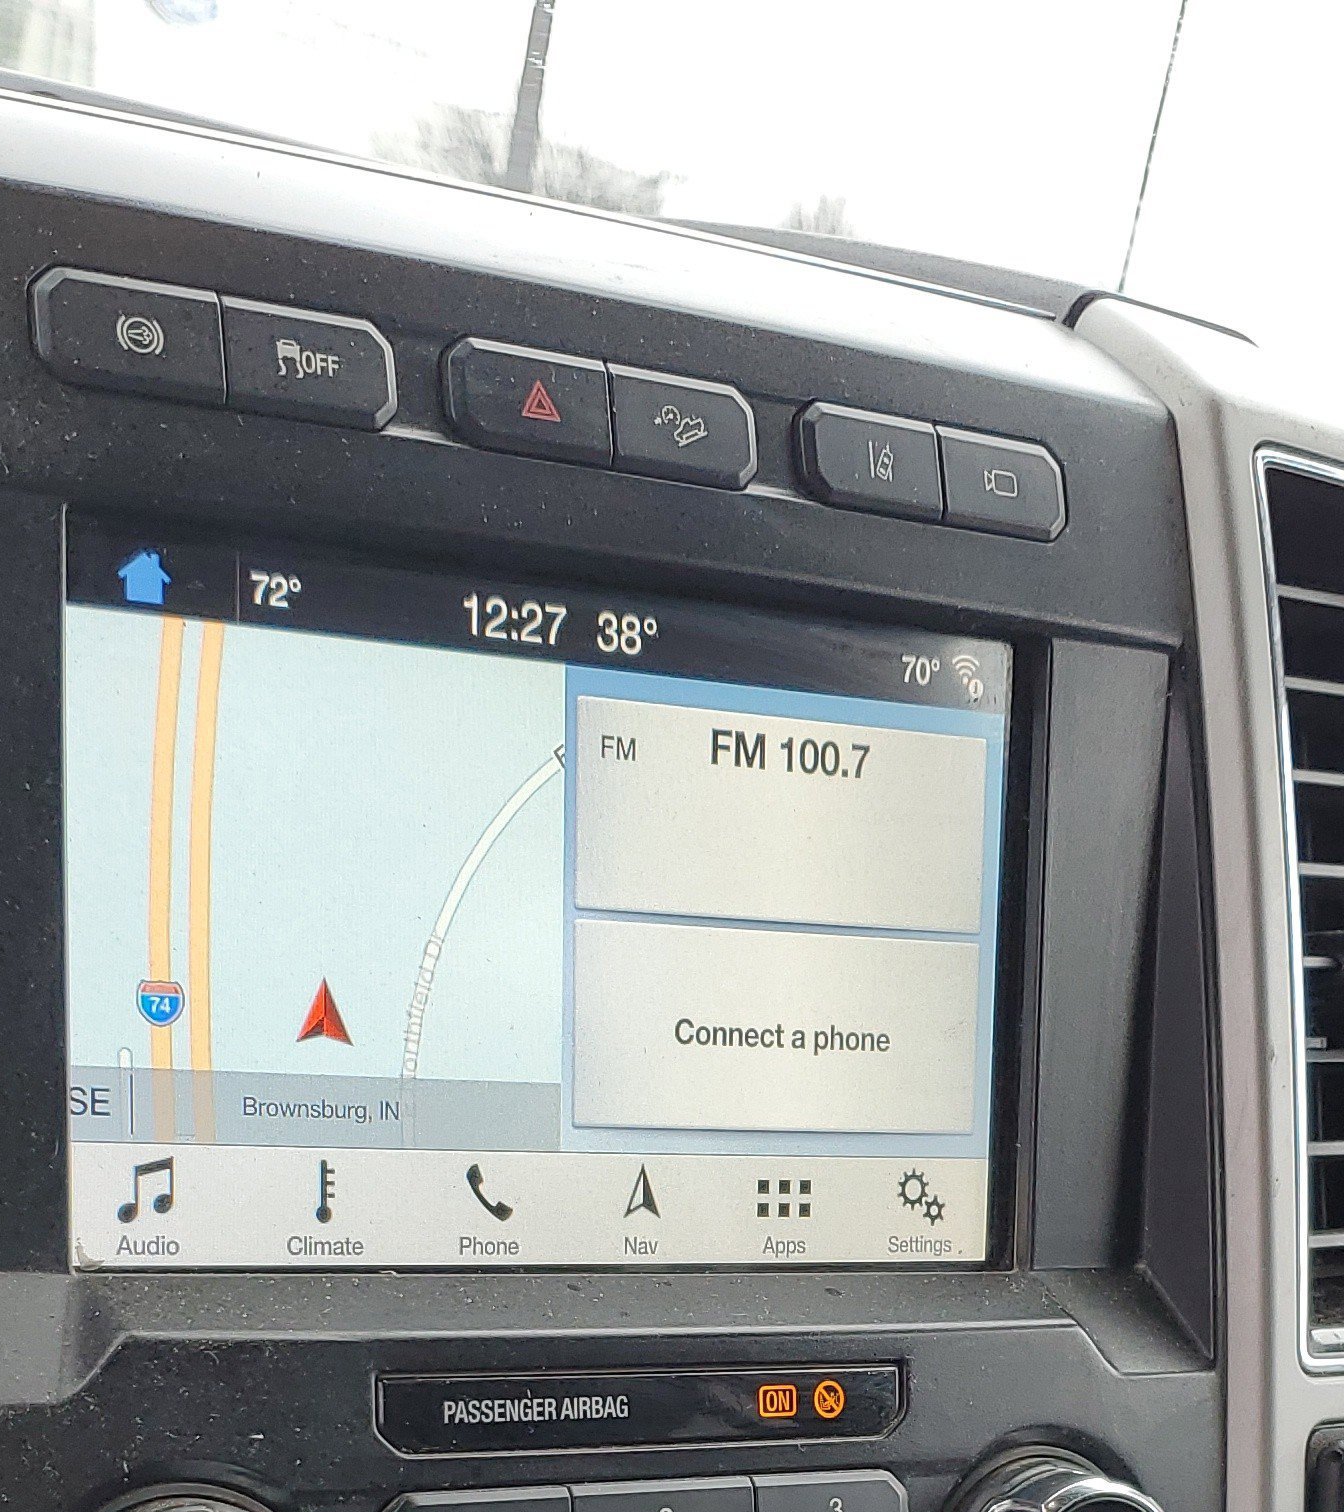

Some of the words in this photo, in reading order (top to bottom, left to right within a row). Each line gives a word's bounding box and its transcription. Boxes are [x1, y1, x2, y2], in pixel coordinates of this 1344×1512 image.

[301, 350, 340, 378] OFF
[463, 592, 567, 645] 12:27
[600, 734, 637, 762] FM
[710, 728, 766, 770] FM
[780, 736, 870, 779] 100.7
[149, 995, 172, 1014] 74
[674, 1018, 785, 1049] Connect
[791, 1029, 806, 1050] a
[813, 1024, 892, 1056] phone
[70, 1086, 111, 1117] SE
[243, 1096, 373, 1124] Brownsburg,
[379, 1100, 401, 1121] IN
[116, 1235, 180, 1256] Audio
[286, 1235, 365, 1256] Climate
[459, 1236, 520, 1256] Phone
[624, 1236, 659, 1255] Nav
[762, 1236, 807, 1258] Apps
[887, 1235, 953, 1259] Settings
[443, 1399, 556, 1425] PASSENGER
[559, 1396, 630, 1421] AIRBAG
[766, 1390, 791, 1413] ON
